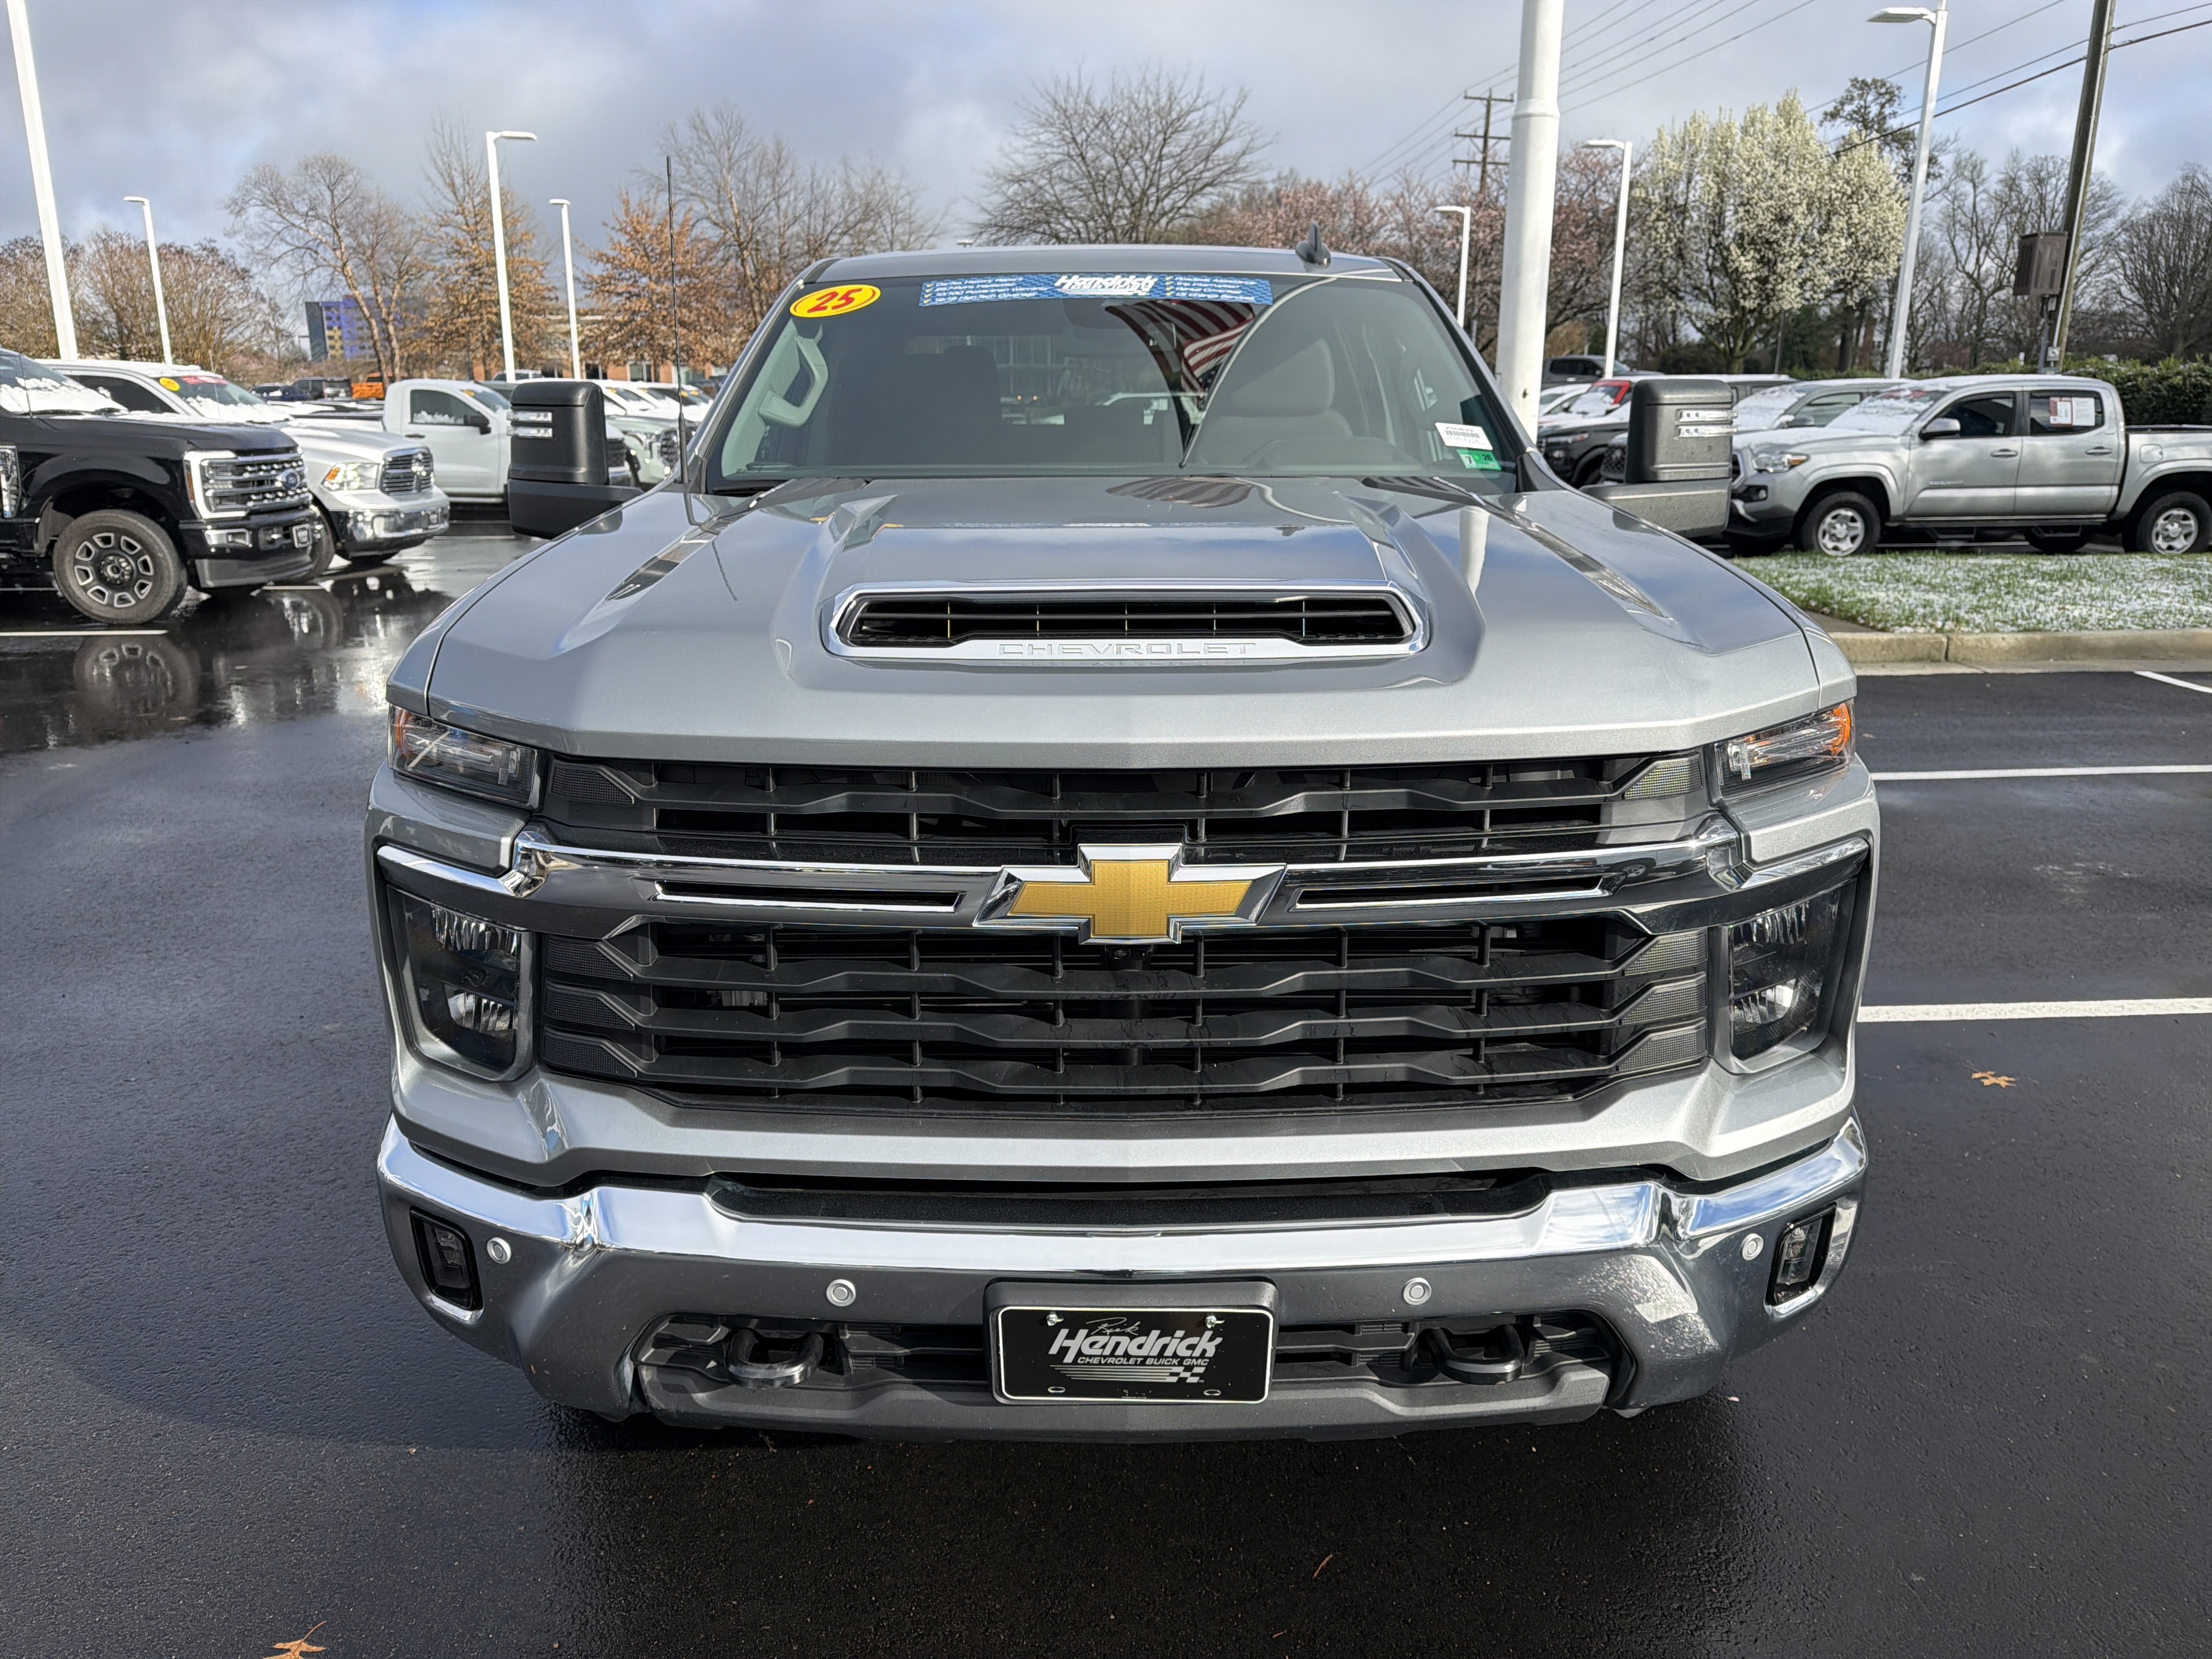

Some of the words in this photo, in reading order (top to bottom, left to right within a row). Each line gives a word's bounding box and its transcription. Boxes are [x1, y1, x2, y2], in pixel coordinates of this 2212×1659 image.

[1054, 275, 1159, 289] Hendrick
[807, 287, 864, 314] 25
[997, 642, 1256, 656] CHEVROLET
[1048, 1328, 1223, 1363] Hendrick
